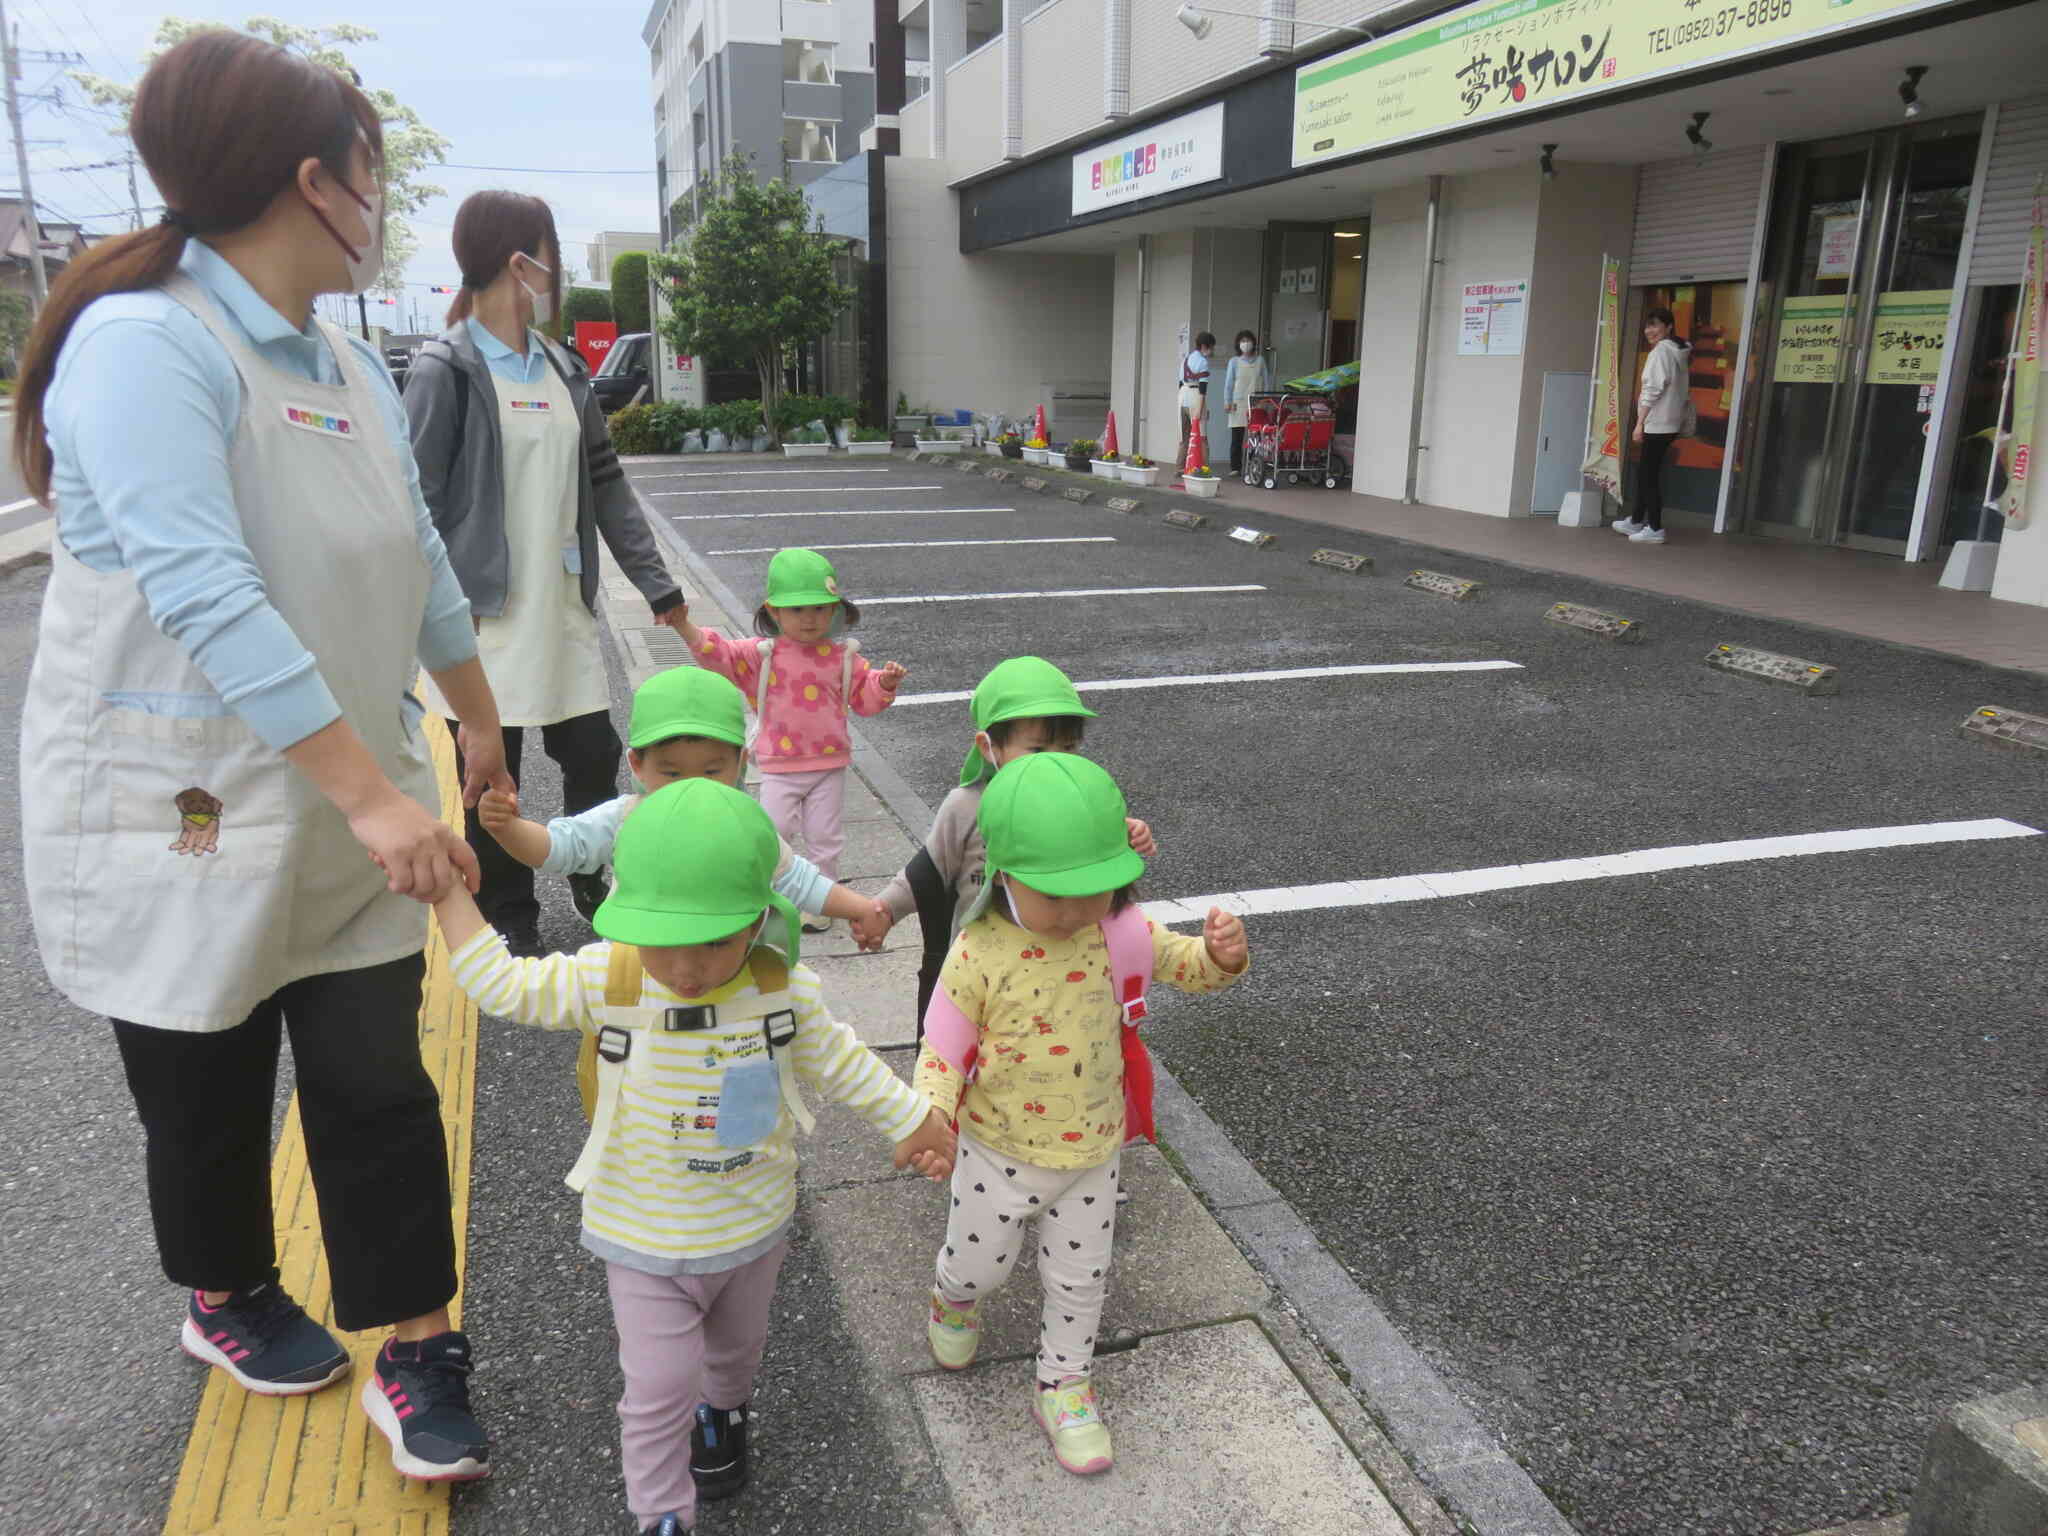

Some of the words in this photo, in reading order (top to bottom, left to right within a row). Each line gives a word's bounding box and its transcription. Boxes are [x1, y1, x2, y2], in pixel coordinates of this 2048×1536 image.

[1456, 25, 1612, 116] 夢咲サロン
